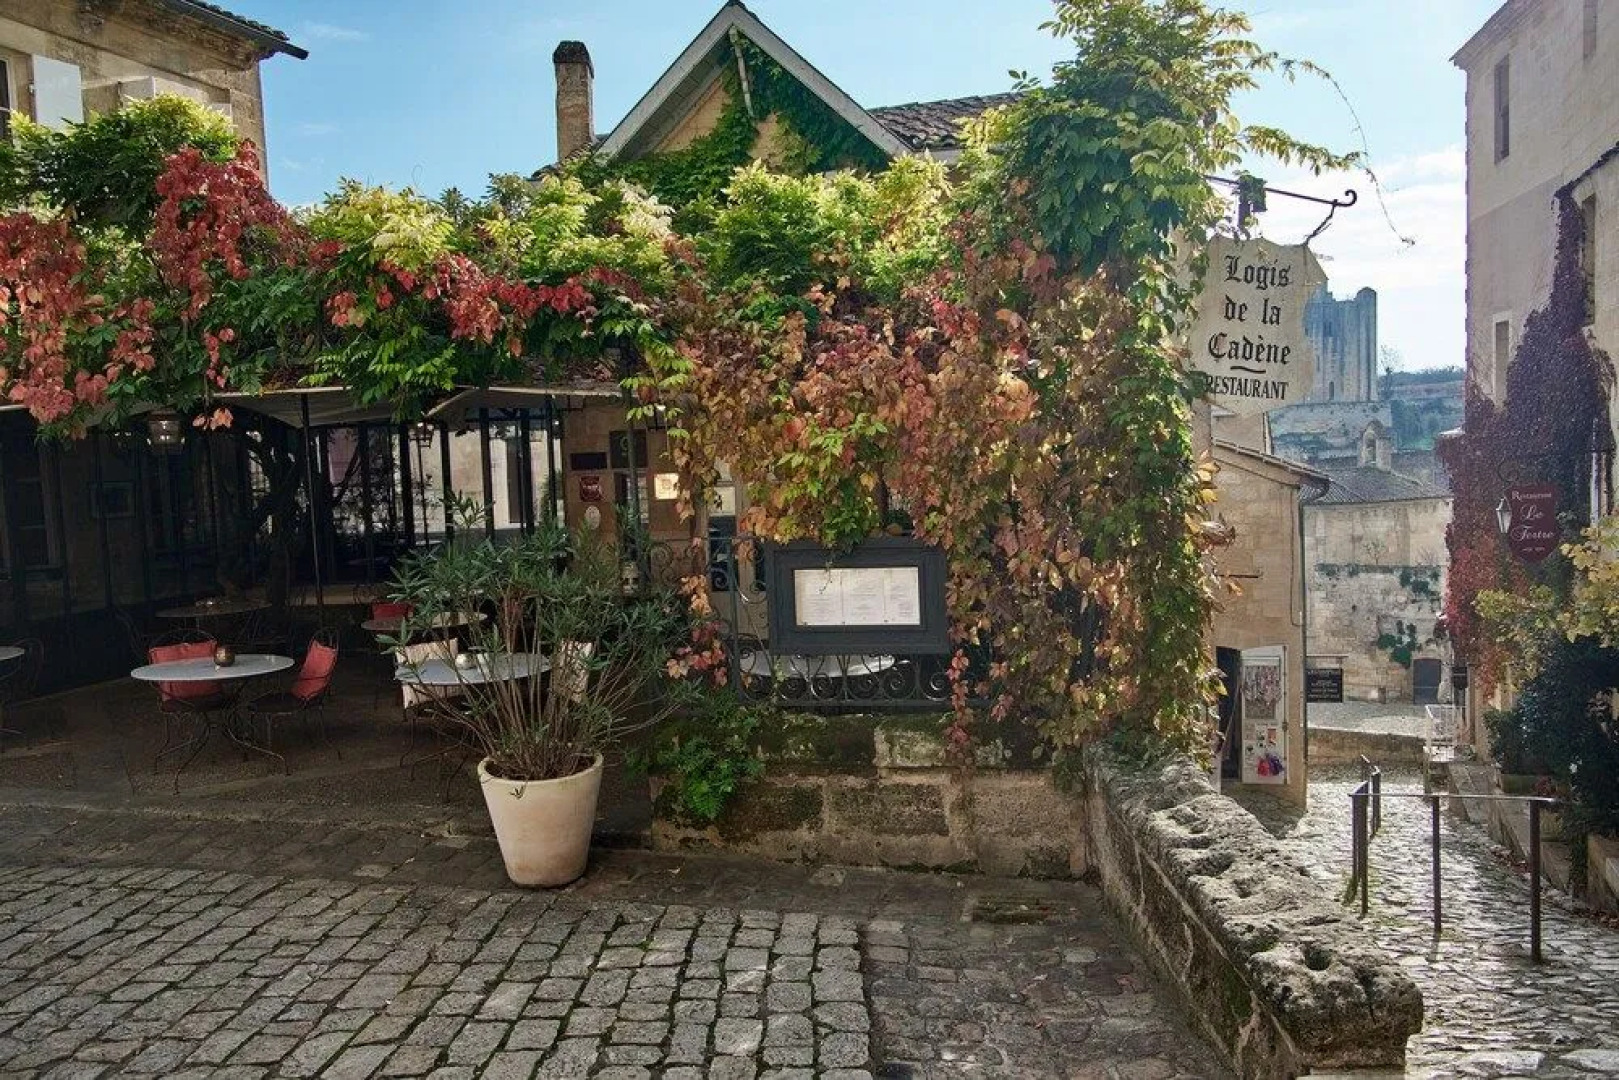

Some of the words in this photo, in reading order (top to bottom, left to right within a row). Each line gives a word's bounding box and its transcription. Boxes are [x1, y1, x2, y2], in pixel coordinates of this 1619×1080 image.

[1224, 255, 1291, 290] Logis
[1224, 294, 1248, 322] de
[1261, 297, 1281, 326] la
[1208, 332, 1291, 365] Cadène
[1205, 375, 1289, 400] RESTAURANT
